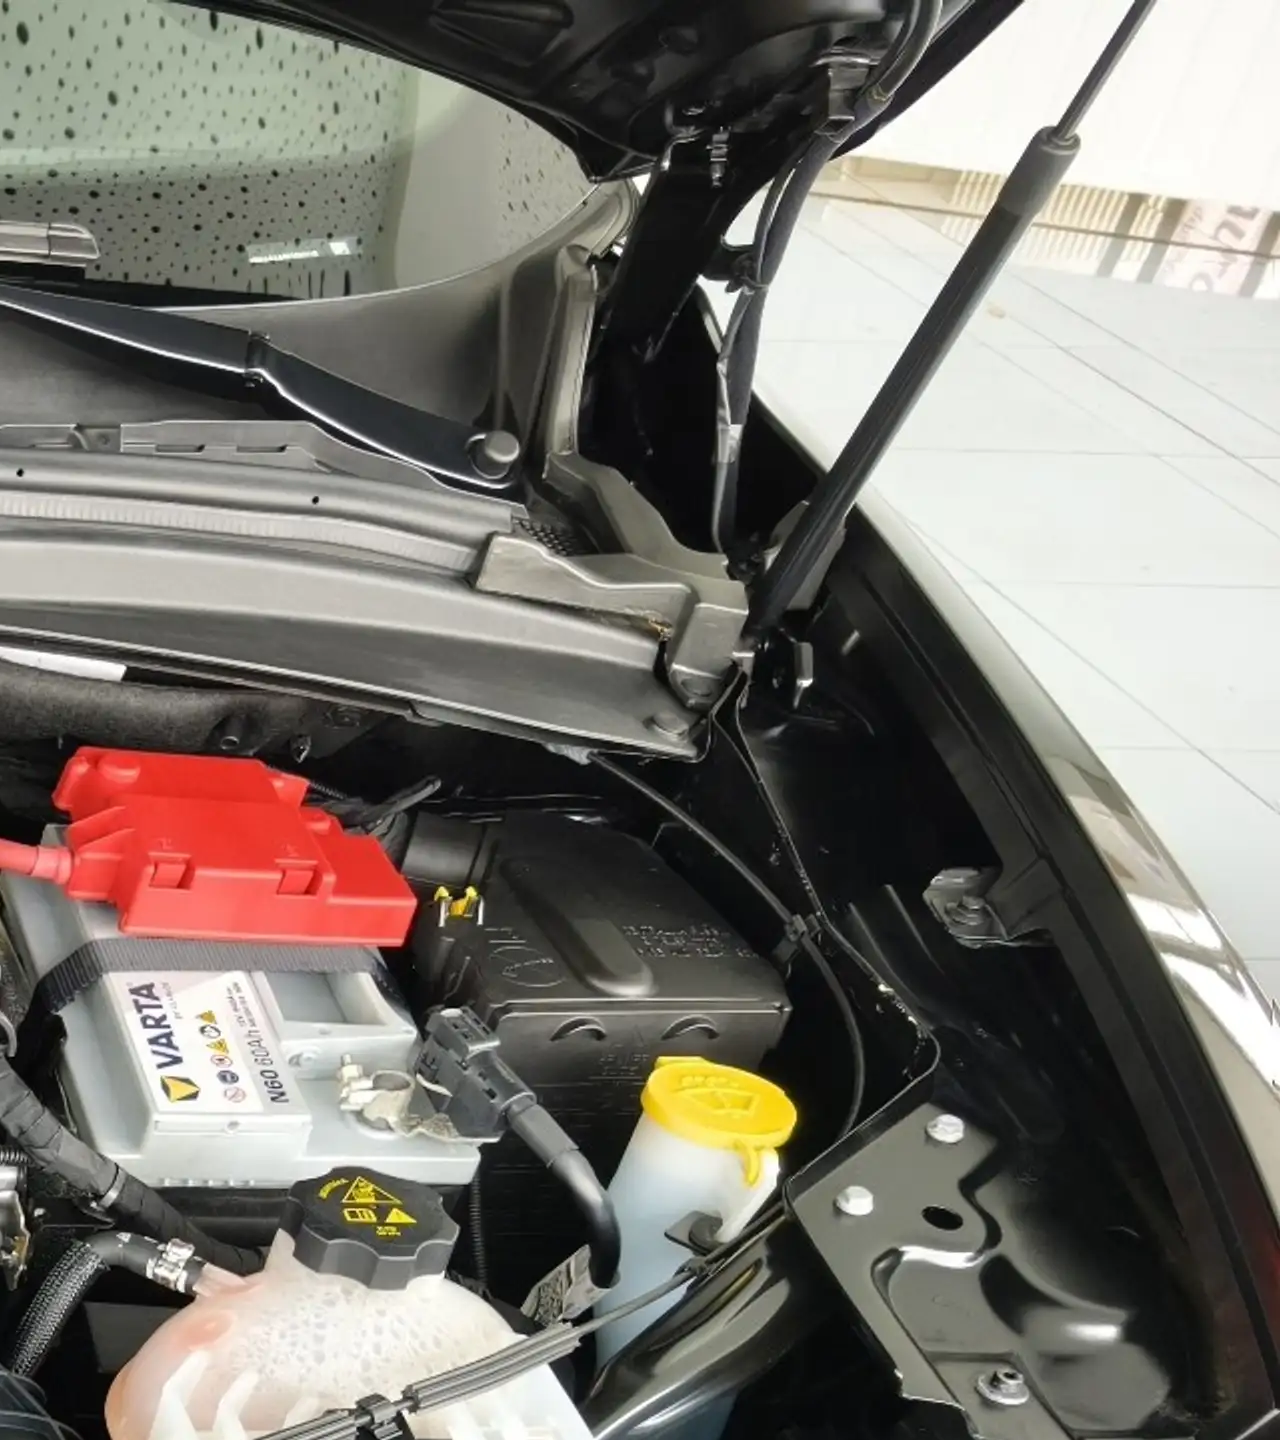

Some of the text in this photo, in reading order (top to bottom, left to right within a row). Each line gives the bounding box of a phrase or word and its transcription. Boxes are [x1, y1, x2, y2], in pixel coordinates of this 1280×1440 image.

[128, 982, 183, 1069] VARTA
[243, 1029, 274, 1067] 60Ah
[260, 1069, 290, 1104] N60
